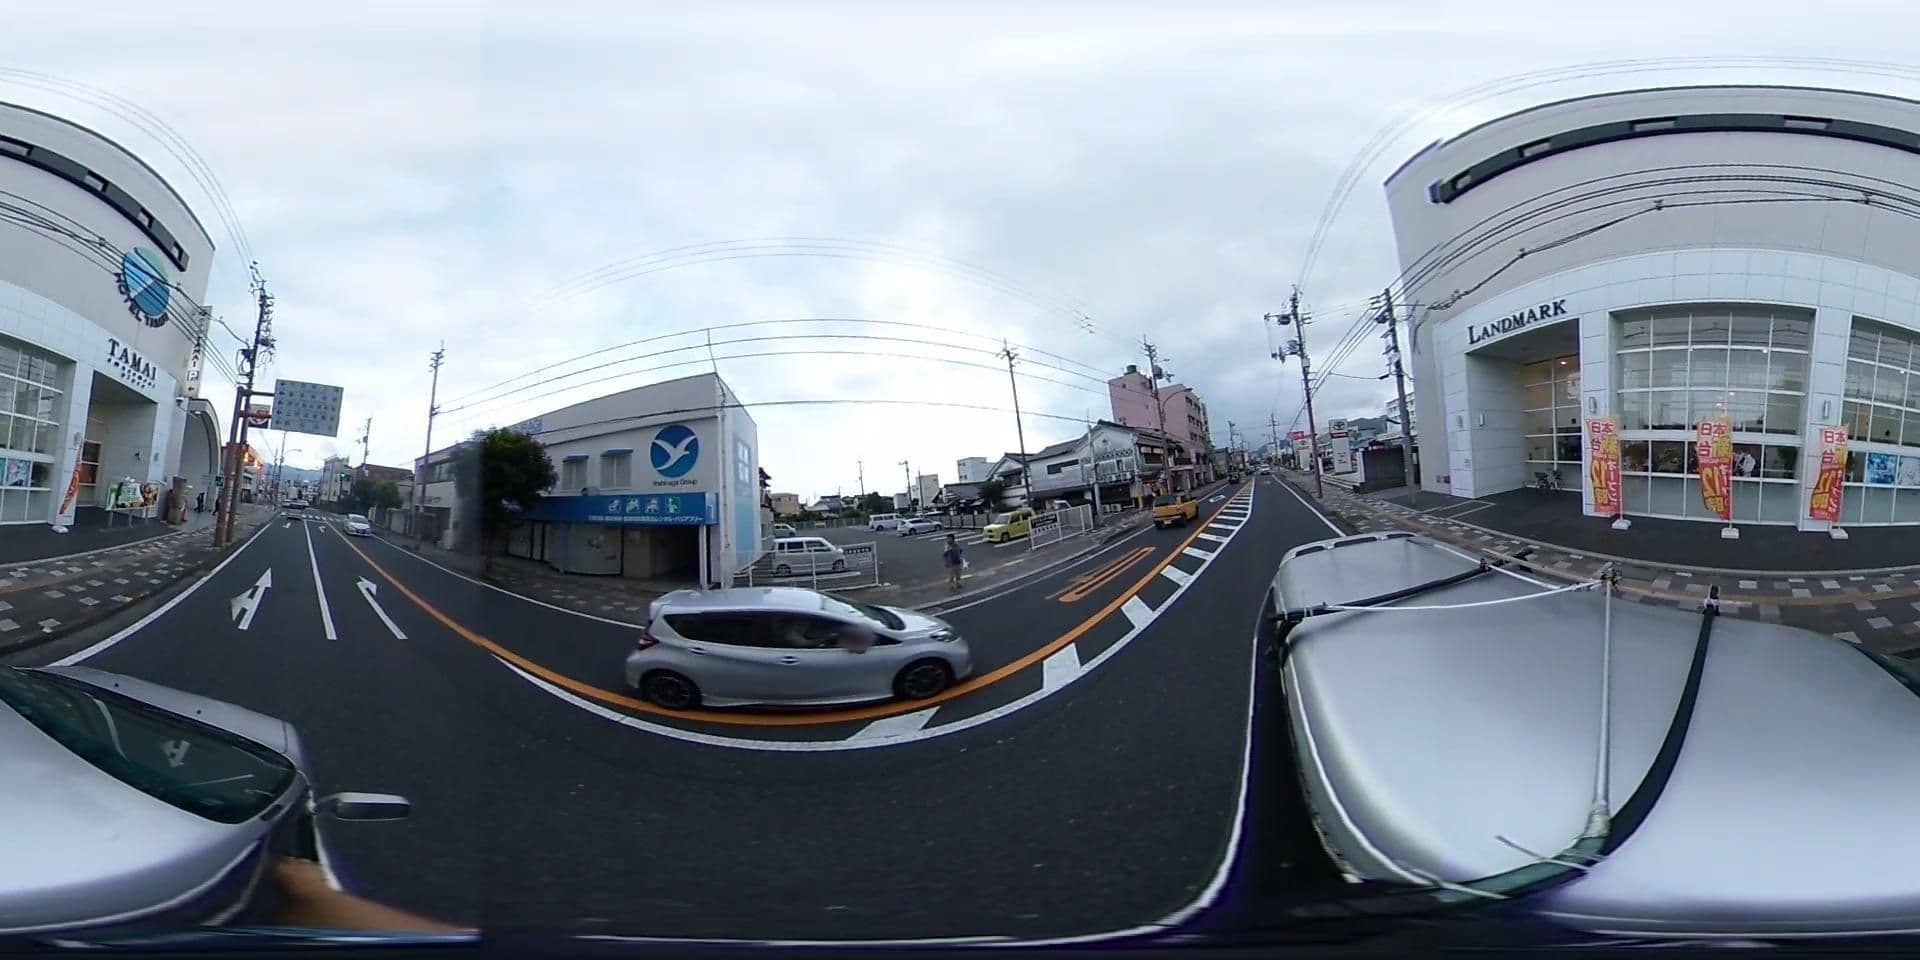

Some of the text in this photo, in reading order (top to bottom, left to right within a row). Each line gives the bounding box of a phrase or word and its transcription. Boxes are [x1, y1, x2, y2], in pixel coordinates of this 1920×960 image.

[114, 272, 143, 323] HOTEL
[1467, 299, 1567, 345] LANDMARK
[108, 338, 158, 381] TAMAI
